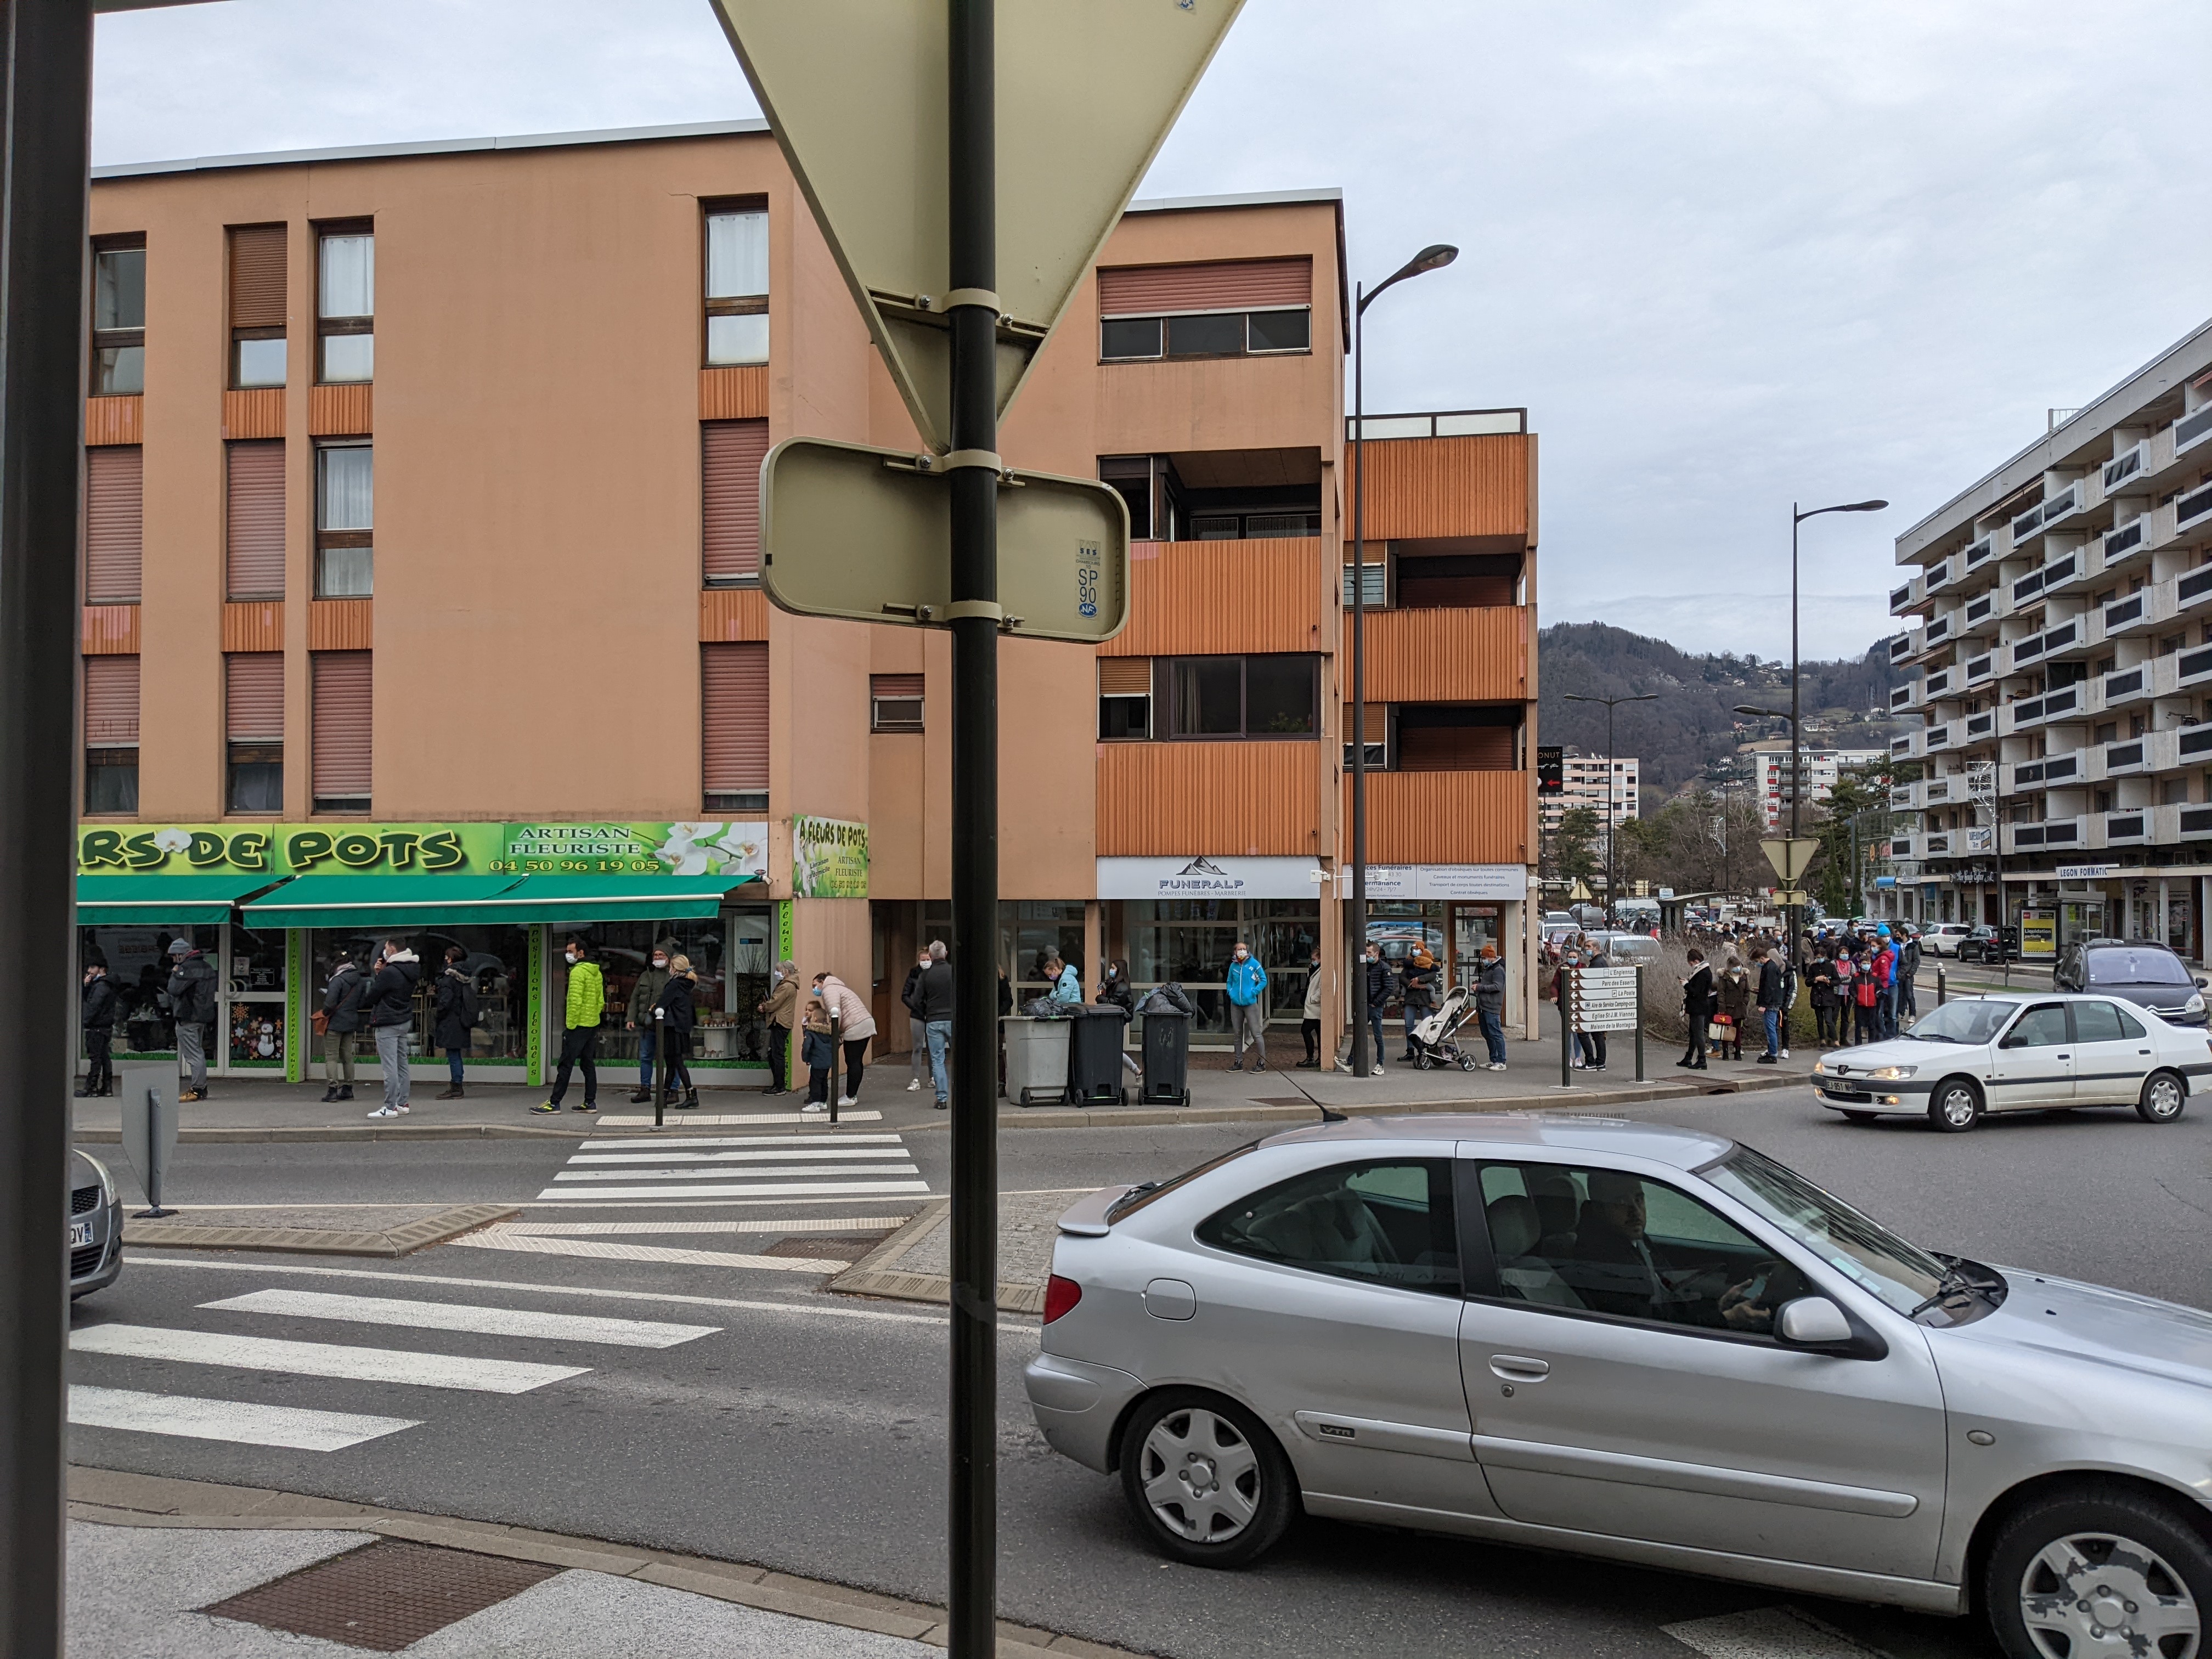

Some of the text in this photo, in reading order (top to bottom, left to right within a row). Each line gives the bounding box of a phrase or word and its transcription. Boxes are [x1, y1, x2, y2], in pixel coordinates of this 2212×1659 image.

[1078, 568, 1098, 586] SP
[1080, 586, 1097, 603] 90
[1081, 604, 1095, 613] NF
[518, 828, 631, 838] ARTISAN
[799, 818, 866, 849] A FLEURS DE POTS
[80, 828, 462, 868] RS DE POTS
[510, 844, 641, 854] FLEURISTE
[489, 860, 660, 871] 04 50 96 19 05
[810, 857, 830, 870] Livraison
[837, 856, 861, 865] ARTISAN
[835, 868, 863, 877] FLEURISTE
[2060, 868, 2078, 877] LEGON
[1159, 879, 1244, 889] FUNERALP
[1322, 1426, 1351, 1437] VTR
